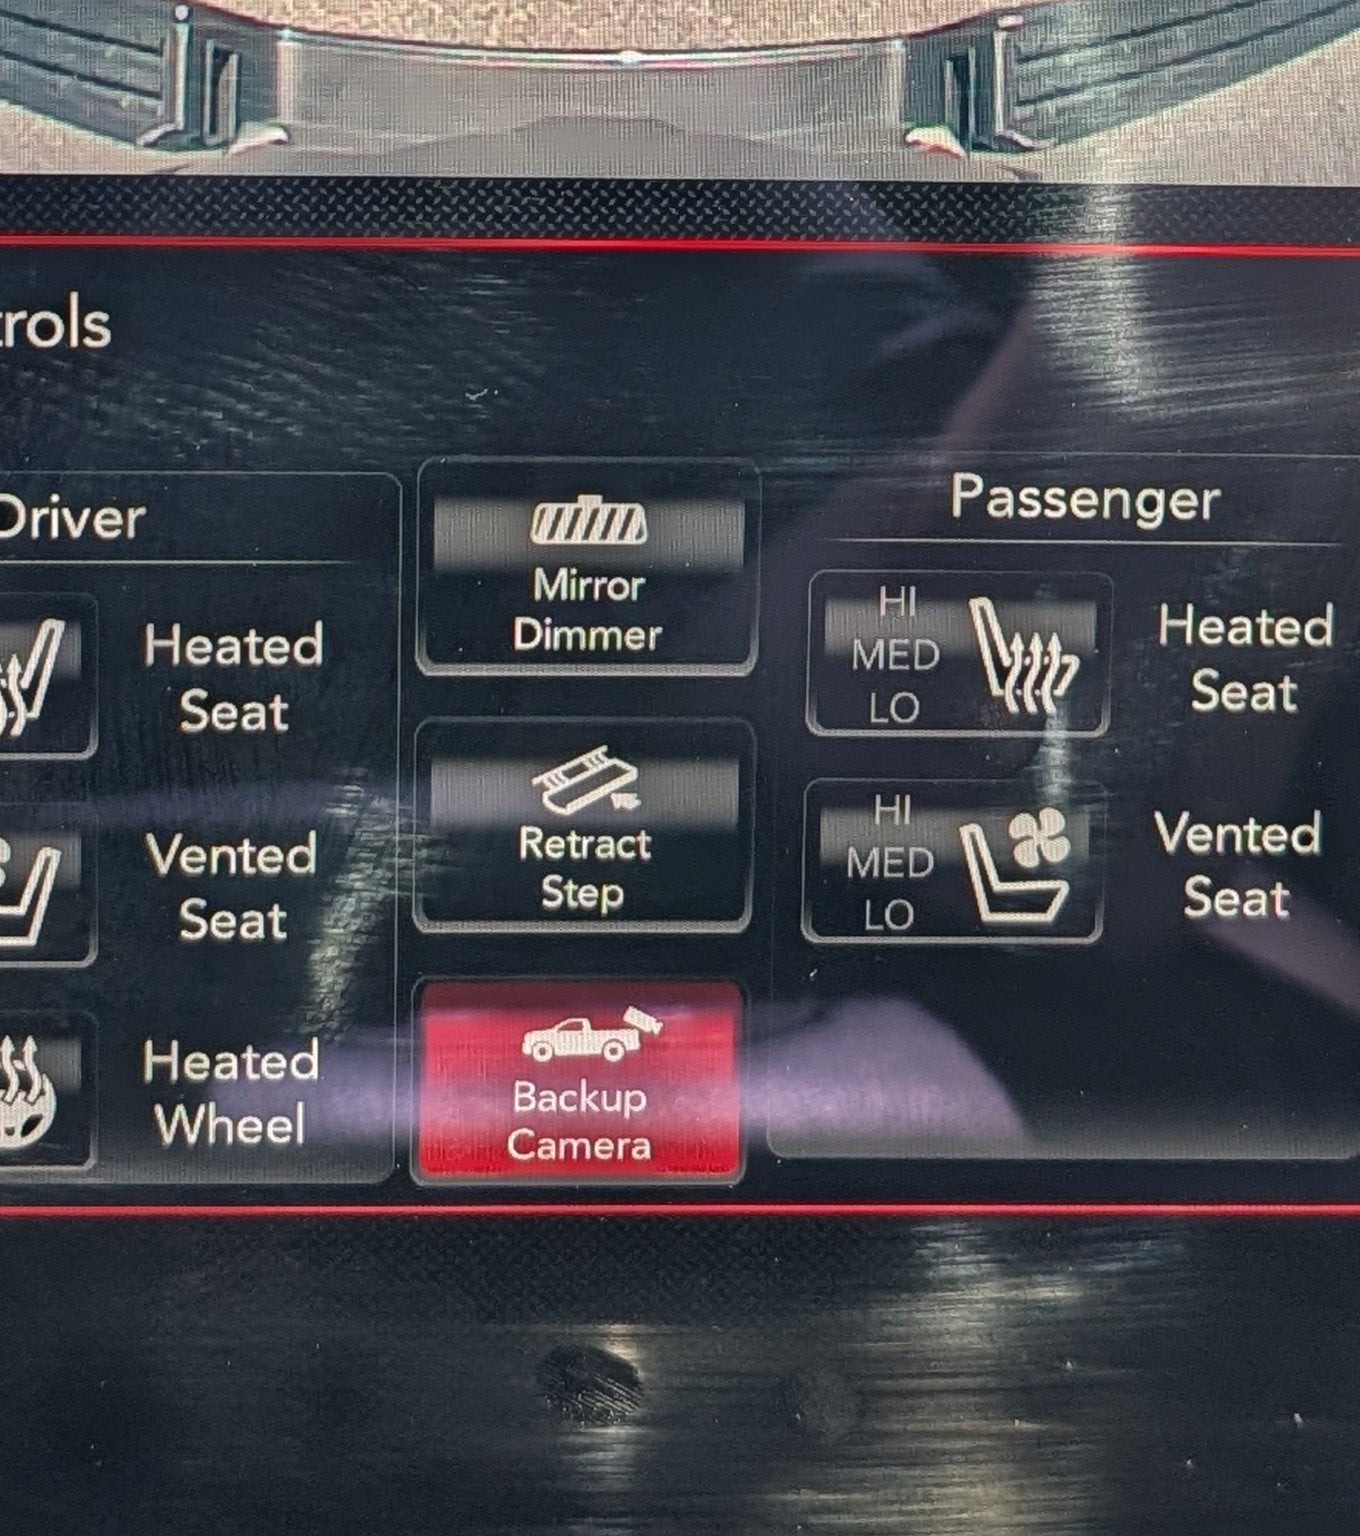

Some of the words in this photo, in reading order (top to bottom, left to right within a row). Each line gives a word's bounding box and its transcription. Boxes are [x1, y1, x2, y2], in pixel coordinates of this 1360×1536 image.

[951, 472, 1223, 530] Passenger
[533, 568, 646, 602] Mirror
[879, 586, 917, 617] HI
[144, 620, 325, 667] Heated
[514, 616, 663, 652] Dimmer
[1159, 602, 1335, 647] Heated
[852, 639, 940, 671] MED
[180, 688, 289, 733] Seat
[869, 692, 920, 724] LO
[1191, 669, 1299, 713] Seat
[874, 795, 912, 826] HI
[145, 830, 319, 877] Vented
[520, 827, 652, 861] Retract
[1154, 810, 1324, 855] Vented
[846, 847, 935, 879] MED
[541, 875, 625, 917] Step
[865, 899, 916, 931] LO
[1183, 875, 1291, 920] Seat
[179, 898, 288, 942] Seat
[142, 1038, 319, 1083] Heated
[513, 1078, 647, 1121] Backup
[153, 1102, 306, 1146] Wheel
[507, 1127, 652, 1161] Camera
